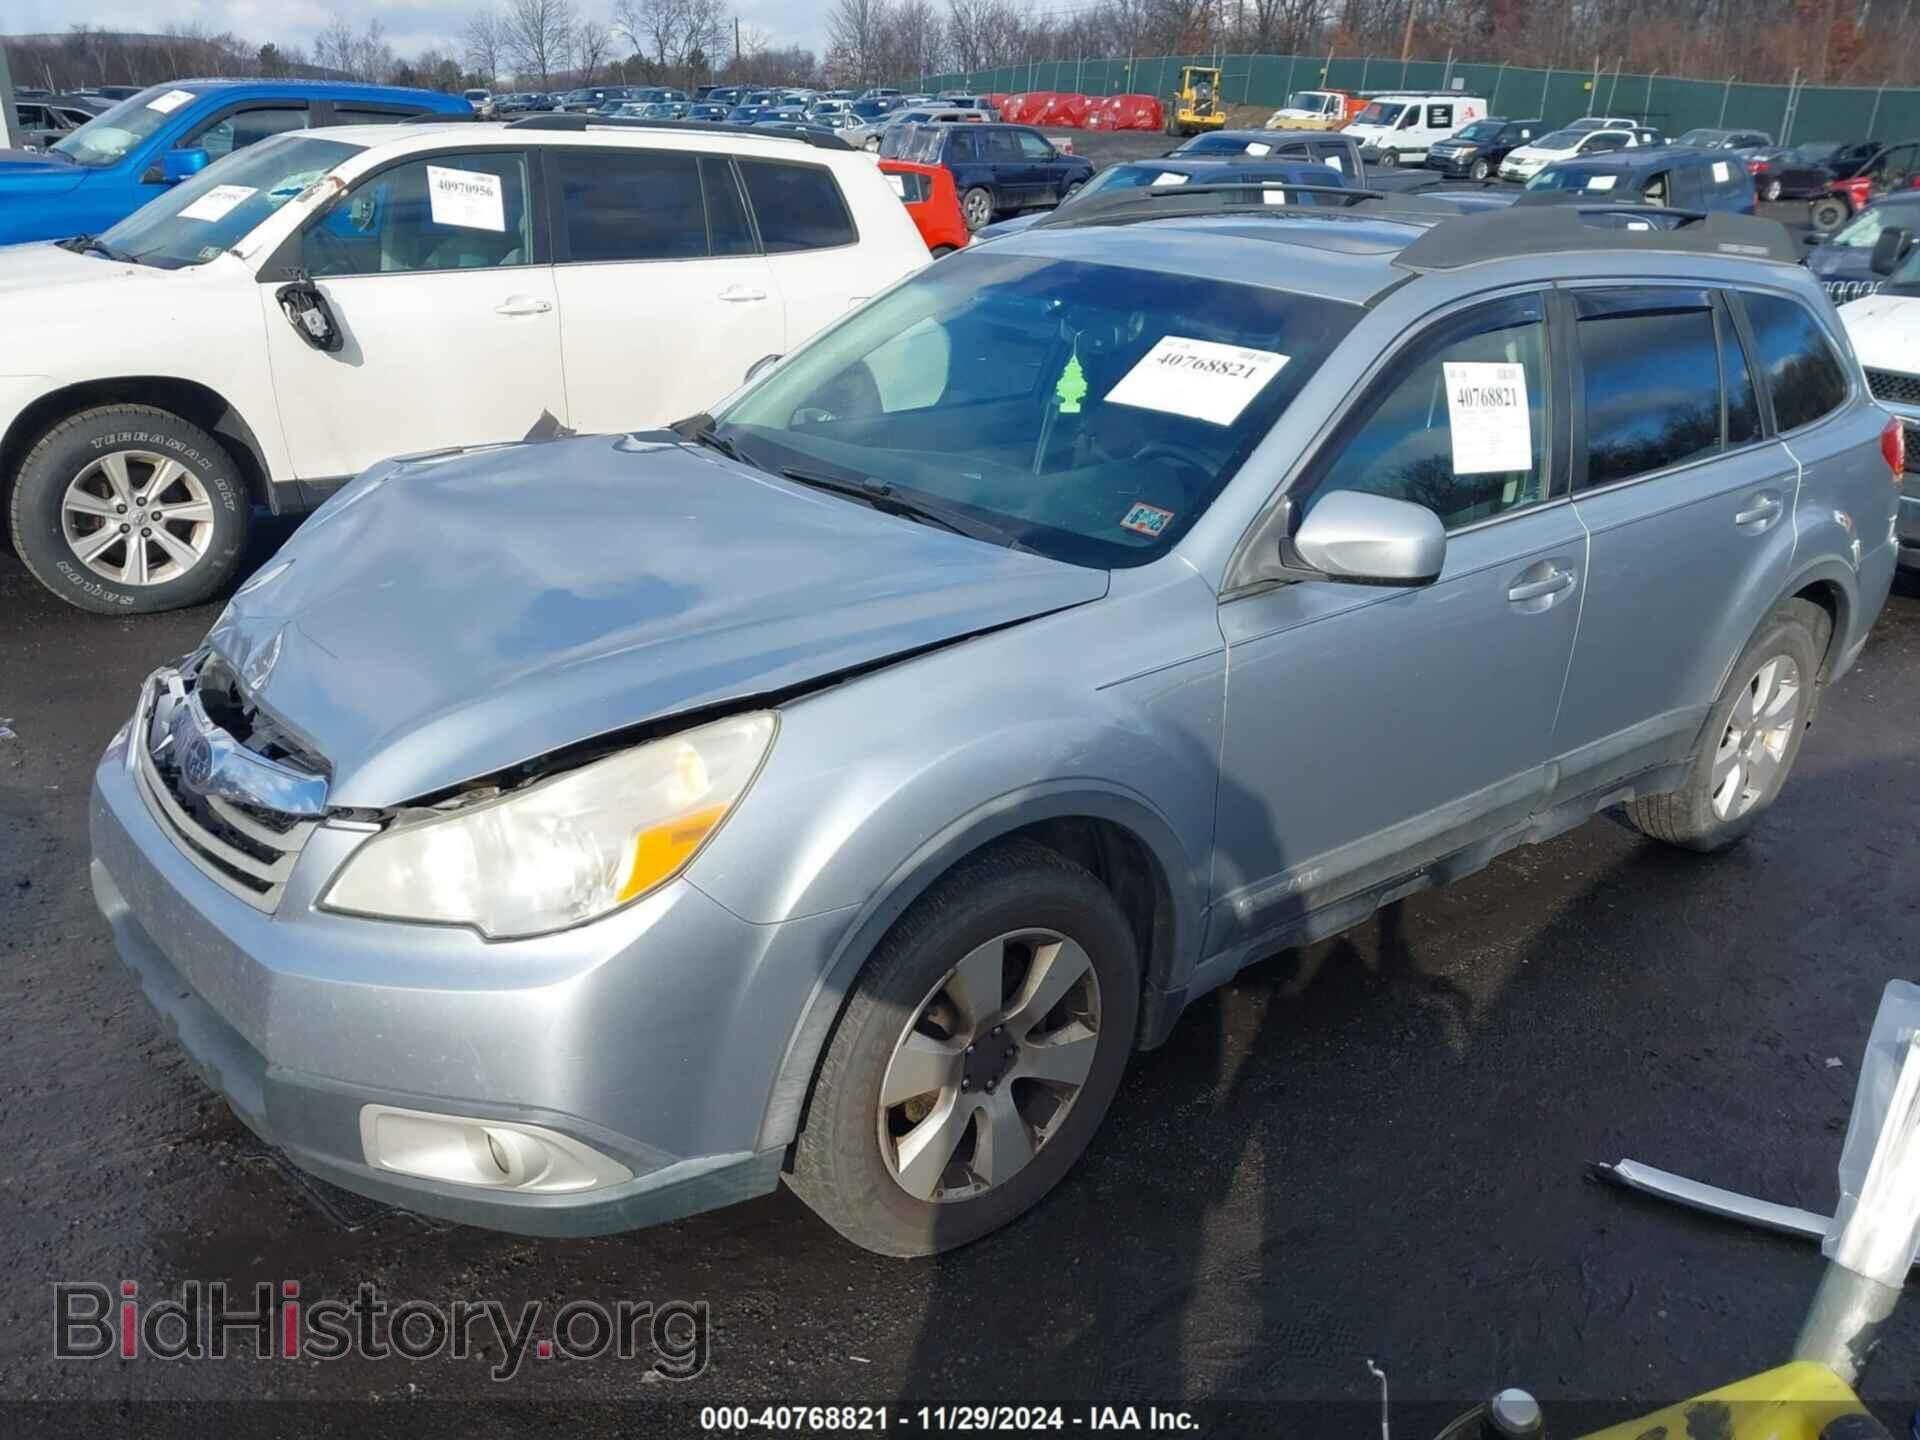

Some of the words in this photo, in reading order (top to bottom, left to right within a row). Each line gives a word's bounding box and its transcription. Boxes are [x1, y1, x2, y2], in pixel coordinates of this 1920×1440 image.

[438, 180, 494, 197] 40970956
[1156, 352, 1257, 379] 40768821
[1457, 387, 1517, 407] 40768821
